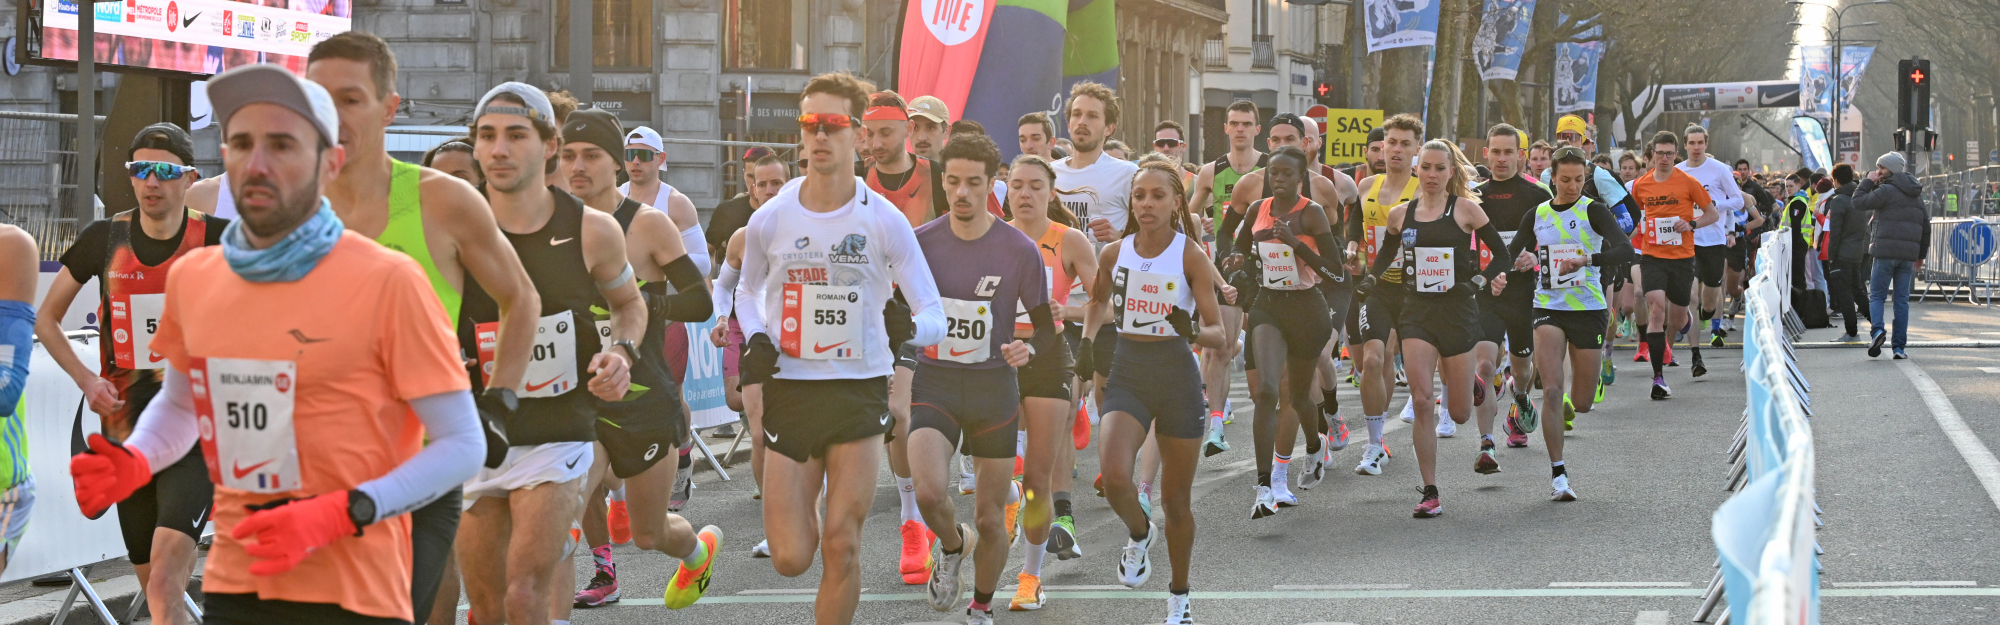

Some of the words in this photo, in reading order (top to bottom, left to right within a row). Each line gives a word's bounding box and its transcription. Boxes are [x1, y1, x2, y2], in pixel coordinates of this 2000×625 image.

[97, 2, 120, 15] Nord
[291, 30, 311, 42] SPORT
[757, 108, 770, 117] DES
[773, 108, 800, 117] VOYAGEU
[1336, 116, 1373, 134] SAS
[1331, 138, 1367, 158] ÉLIT
[782, 251, 823, 261] CRYOTERA
[828, 253, 869, 265] VEMA
[1268, 252, 1279, 260] 401
[787, 267, 828, 283] STADE
[1417, 268, 1451, 277] JAUNET
[1141, 284, 1159, 294] 403
[816, 293, 846, 301] ROMAIN
[1126, 297, 1172, 316] BRUN
[814, 309, 847, 325] 553
[946, 317, 986, 340] 250
[530, 342, 556, 361] 01
[220, 373, 273, 386] BENJAMIN
[226, 401, 268, 431] 510
